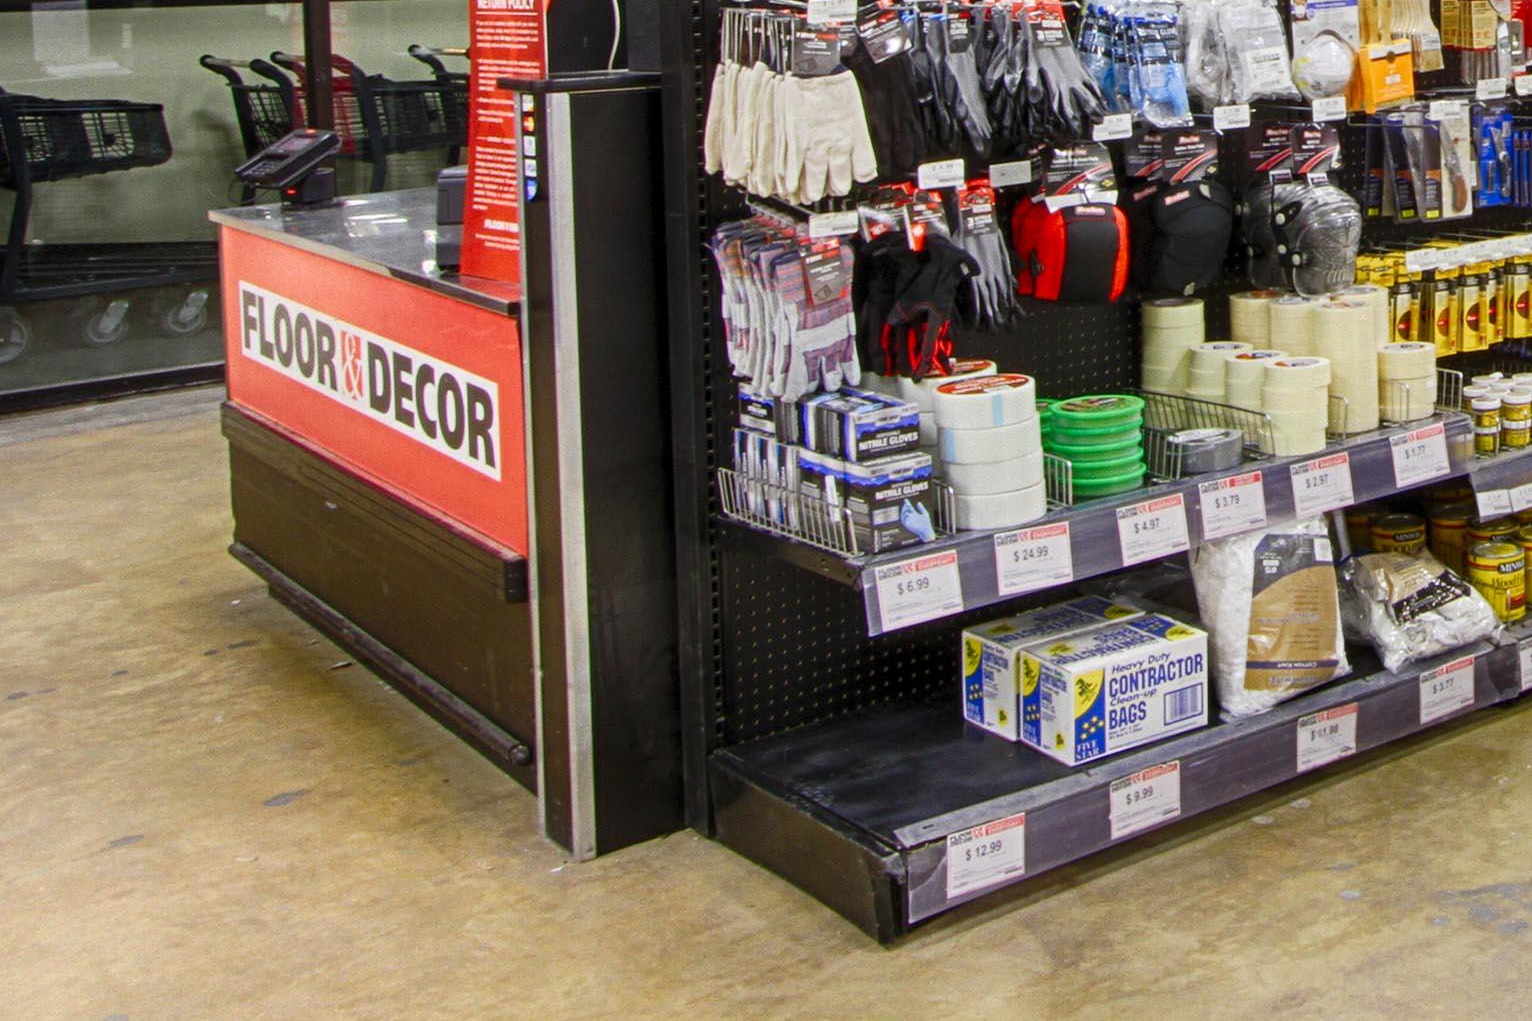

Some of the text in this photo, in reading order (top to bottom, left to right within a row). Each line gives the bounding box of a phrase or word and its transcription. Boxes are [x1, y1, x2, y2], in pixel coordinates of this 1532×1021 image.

[242, 290, 496, 469] FLOOR & DECOR
[859, 438, 889, 451] NITRILE
[889, 432, 919, 445] GLOVES
[875, 481, 929, 500] NITRILE GLOVES
[1142, 518, 1160, 530] 4.97
[1013, 545, 1049, 562] $ 24.99
[897, 577, 930, 595] $ 6.99
[1111, 651, 1171, 674] Heavy Duty
[1109, 653, 1204, 698] CONTRACTOR
[1110, 688, 1158, 707] Clean-up
[1109, 701, 1147, 729] BAGS
[1075, 748, 1100, 761] STAR
[1076, 739, 1097, 753] FIVE
[1134, 785, 1153, 802] 9.99
[966, 840, 1002, 861] $ 12.99
